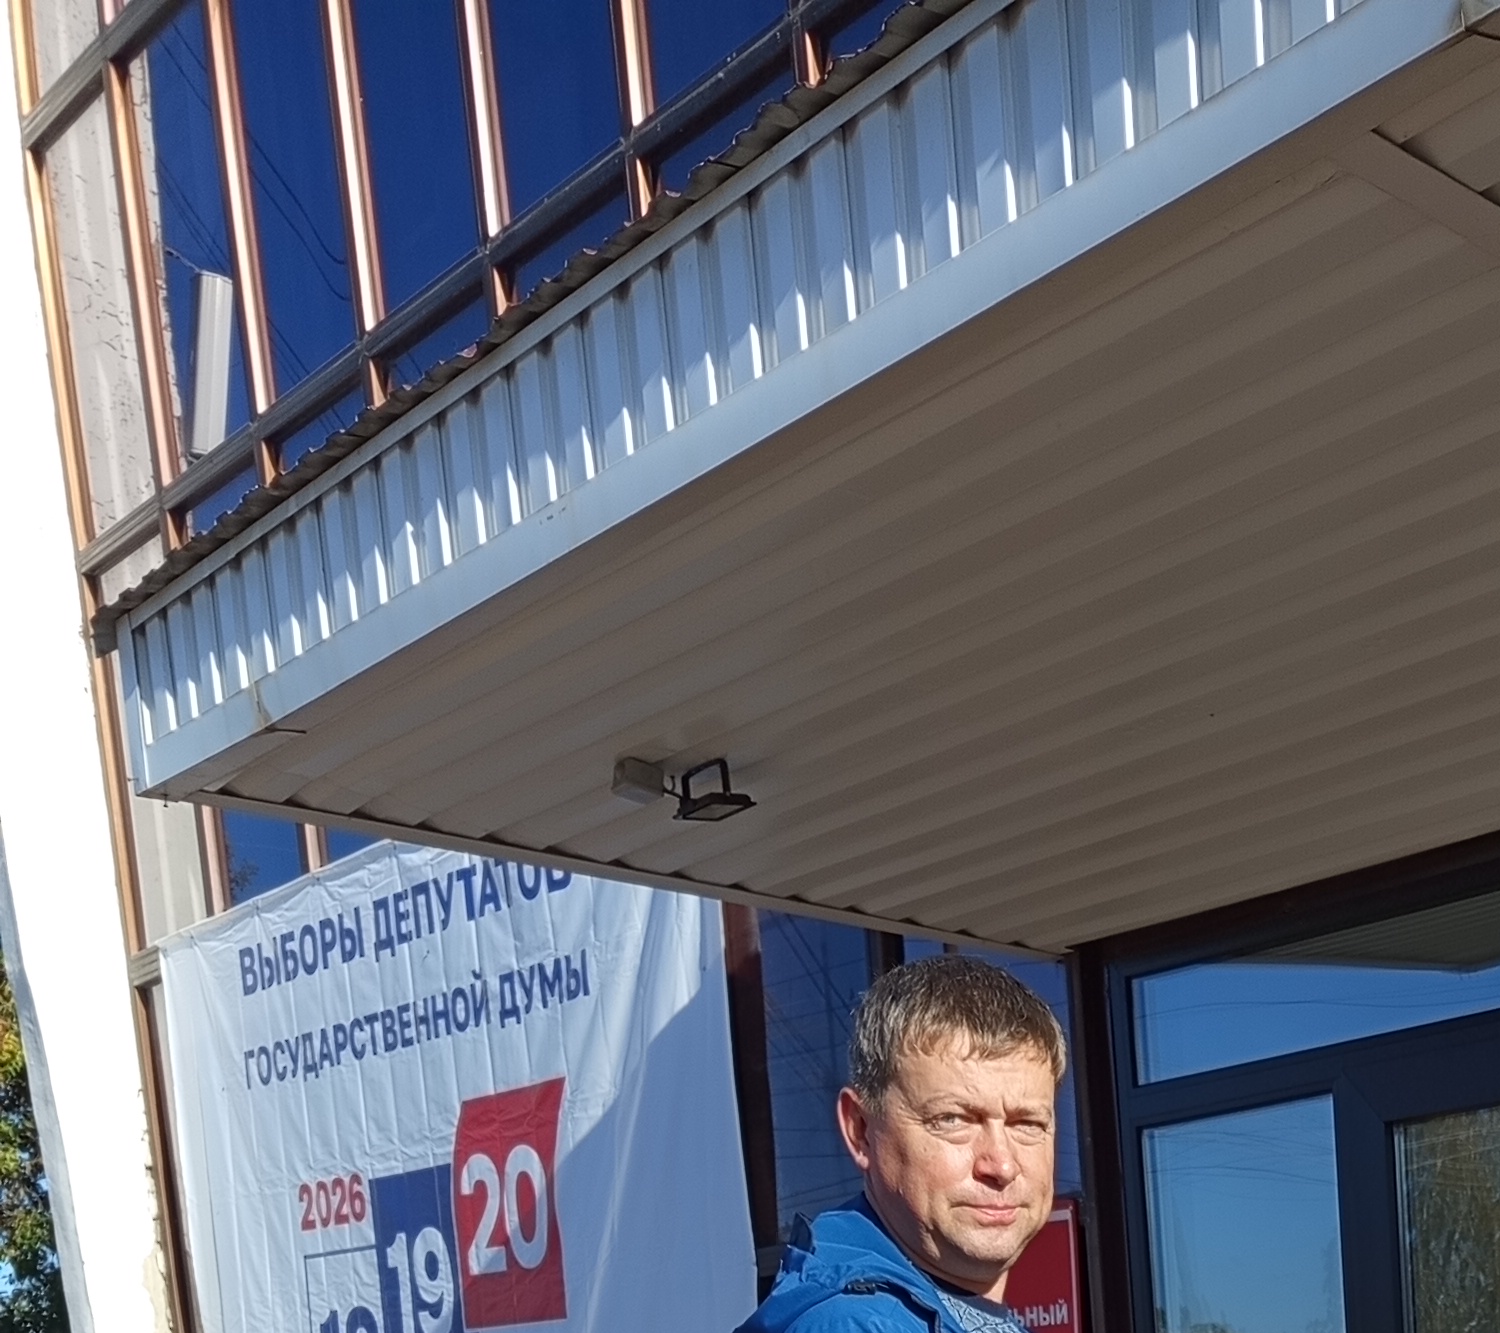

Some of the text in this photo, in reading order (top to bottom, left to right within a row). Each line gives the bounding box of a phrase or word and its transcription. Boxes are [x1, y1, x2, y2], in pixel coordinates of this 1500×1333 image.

[238, 905, 365, 997] ВЫБОРЫ
[243, 949, 591, 1091] ГОСУДАРСТВЕННОЙ ДУМЫ
[299, 1173, 366, 1232] 2026
[461, 1144, 548, 1276] 20
[1007, 1298, 1069, 1328] ЬНЫЙ
